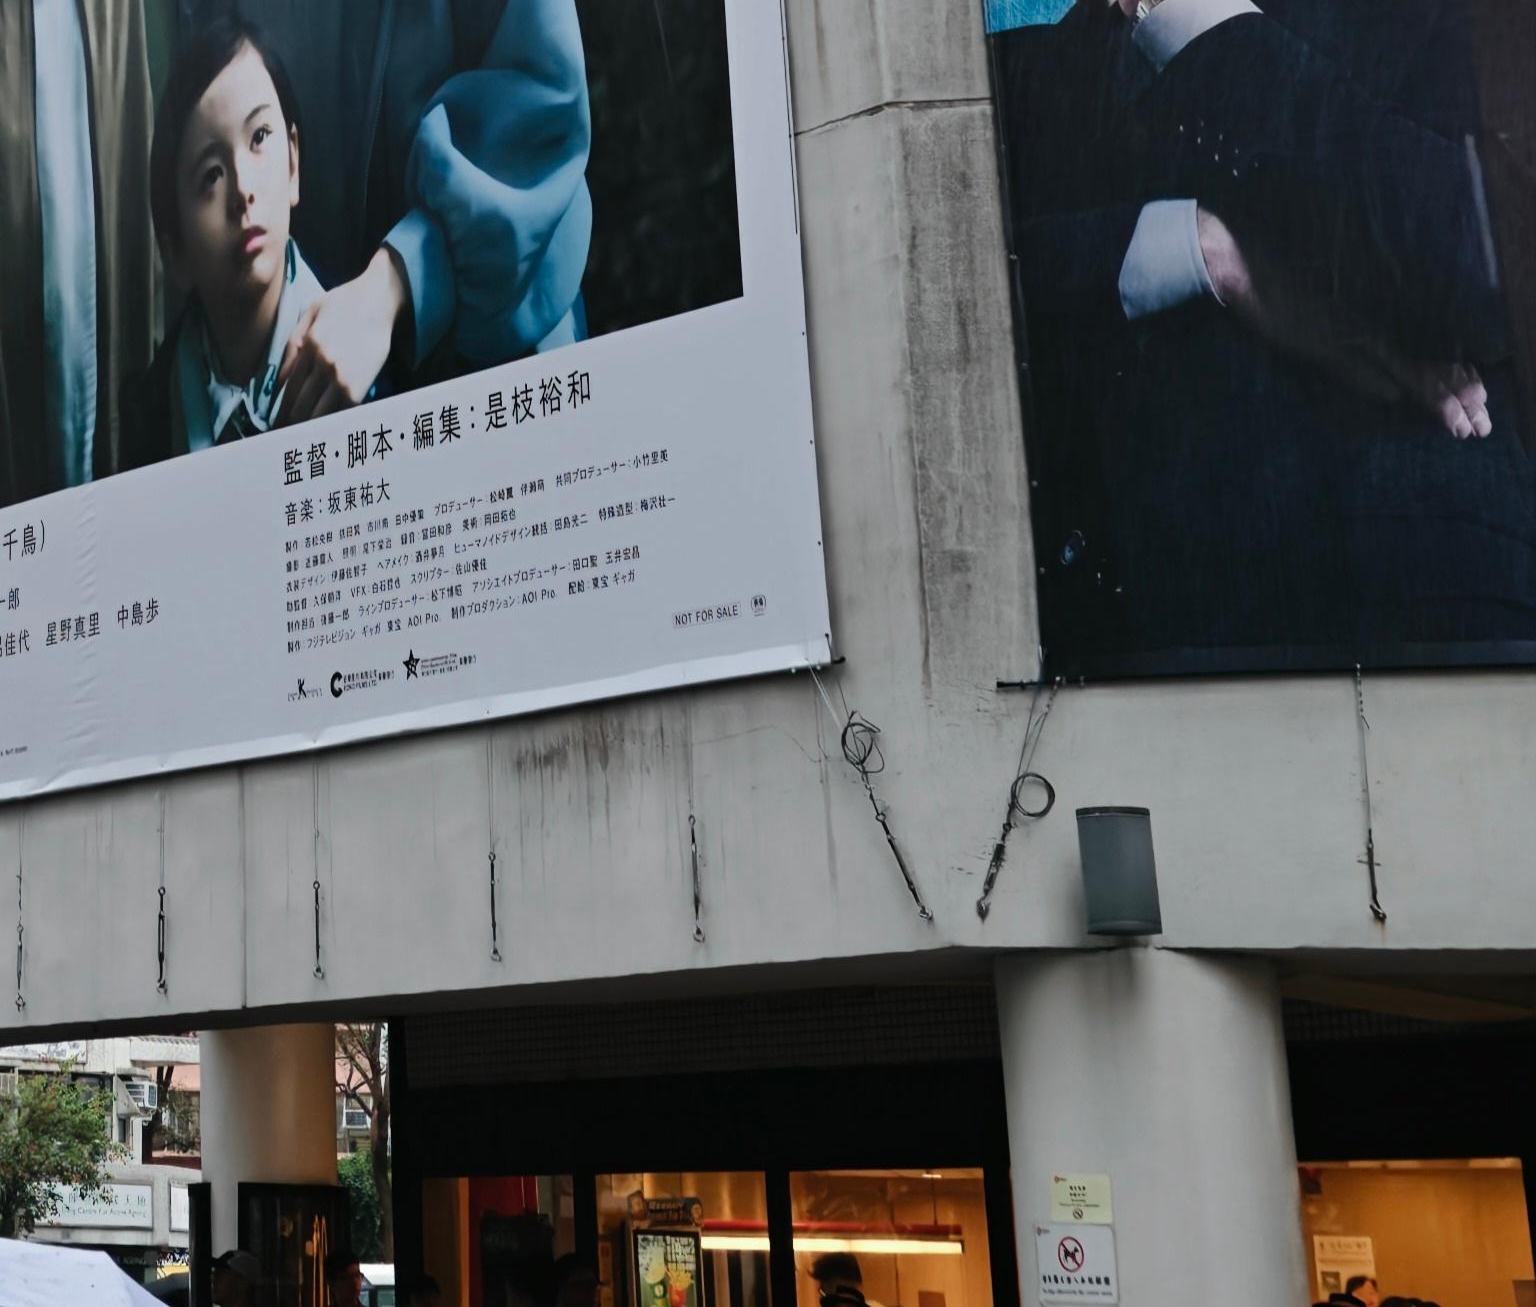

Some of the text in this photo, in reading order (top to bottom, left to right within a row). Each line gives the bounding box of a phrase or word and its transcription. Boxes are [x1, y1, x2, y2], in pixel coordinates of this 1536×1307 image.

[45, 612, 101, 647] 星野真里
[117, 598, 159, 630] 中島歩
[675, 613, 692, 625] NOT
[696, 609, 713, 622] FOR
[716, 604, 738, 619] SALE
